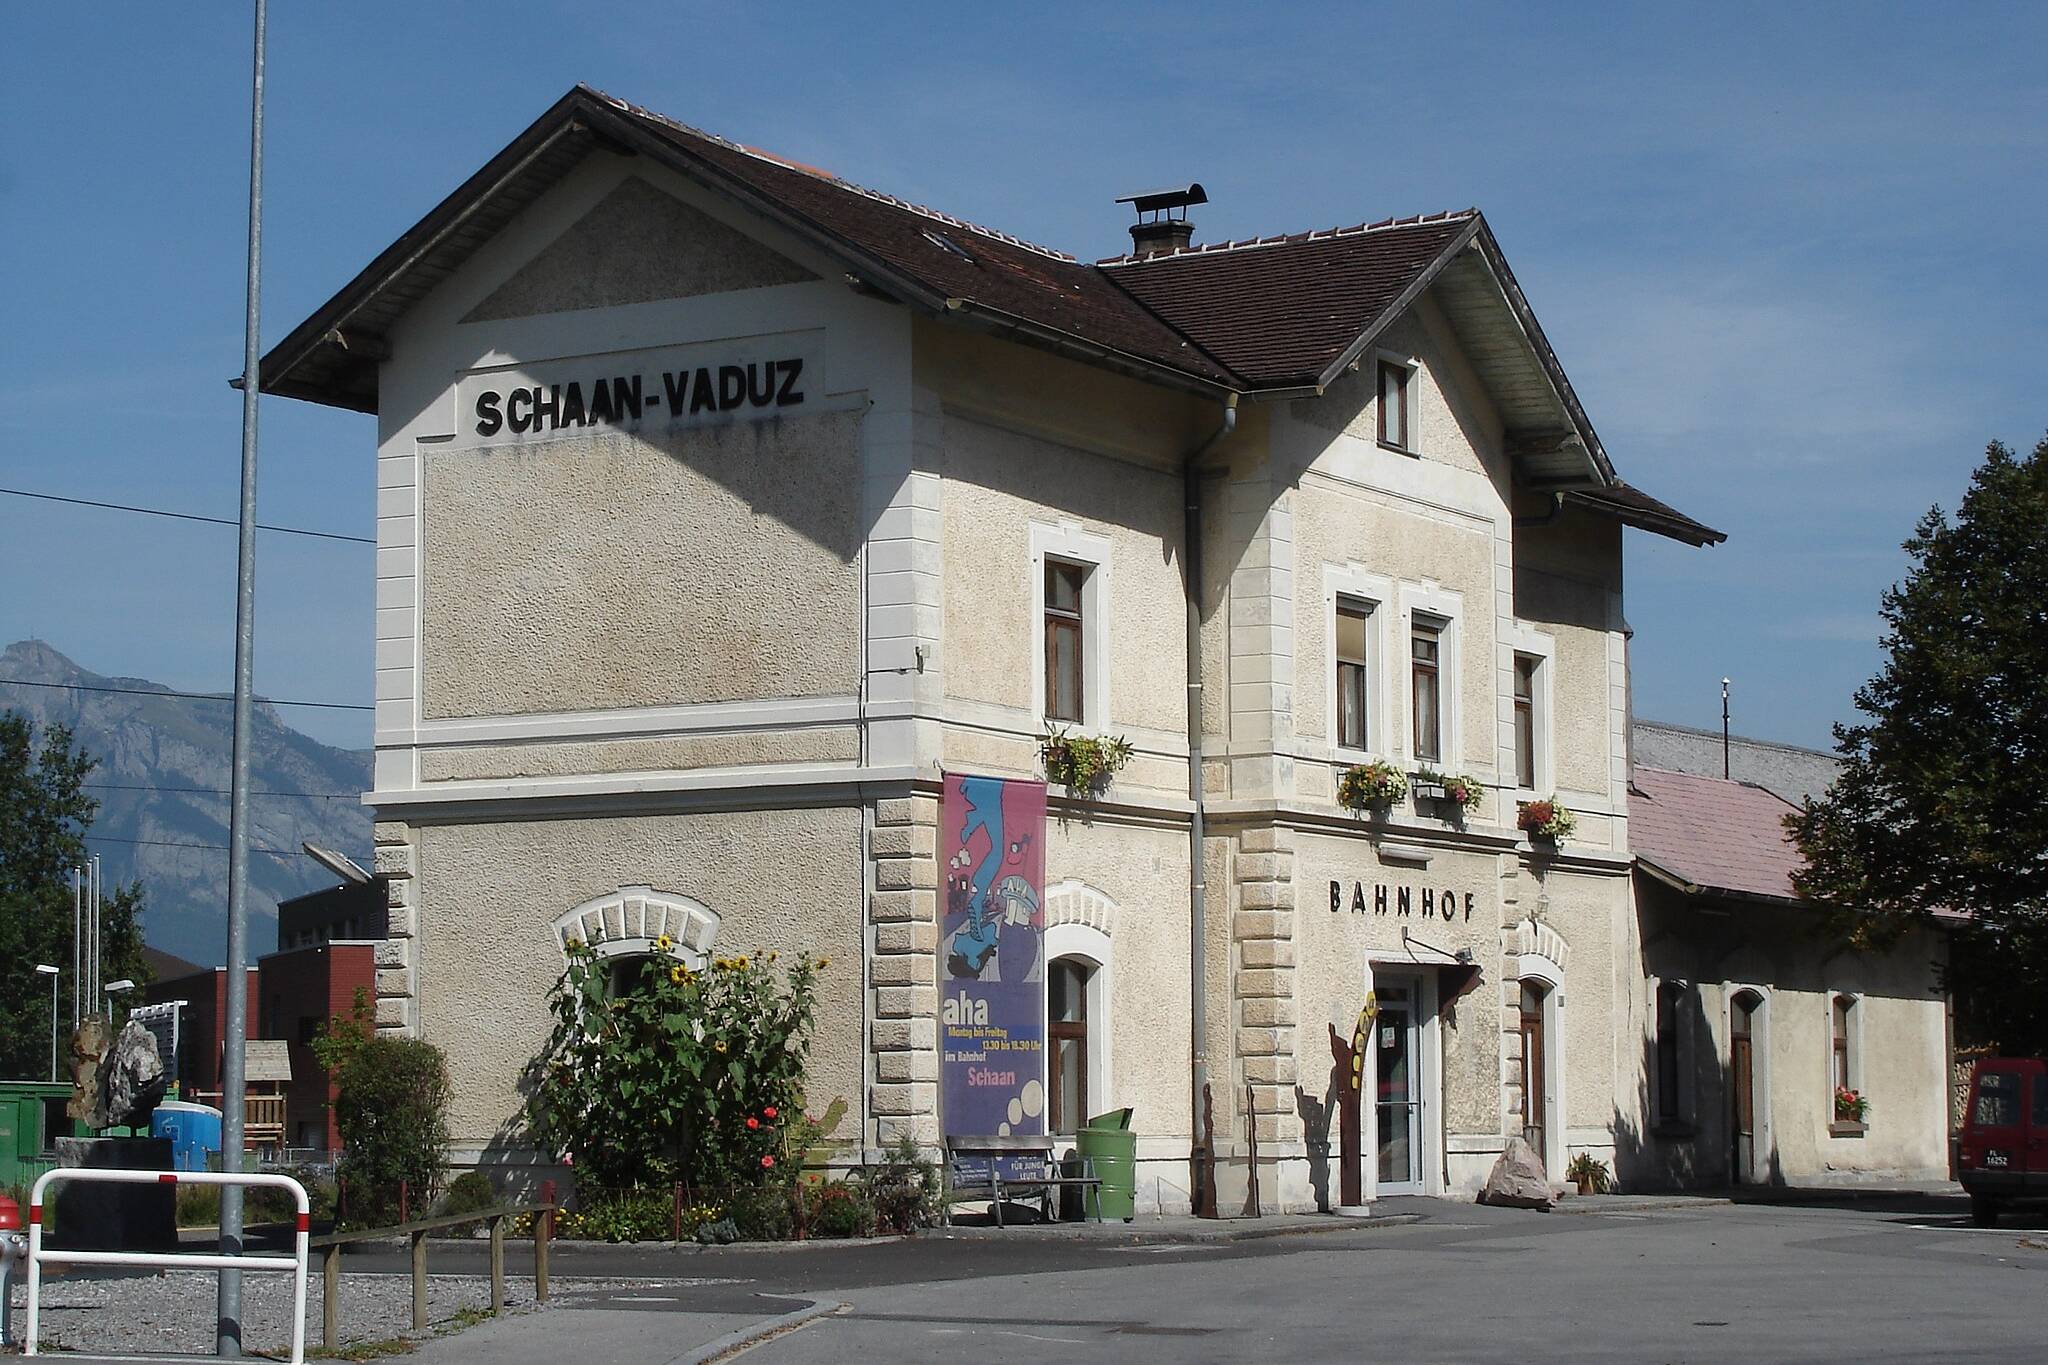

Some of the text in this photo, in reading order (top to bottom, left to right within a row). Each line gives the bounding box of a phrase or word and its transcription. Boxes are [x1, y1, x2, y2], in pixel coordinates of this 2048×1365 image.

[474, 357, 805, 438] SCHAAN-VADUZ
[1329, 879, 1475, 924] BAHNHOF
[943, 990, 989, 1026] aha
[948, 1026, 1008, 1040] Montag bis Freitag
[1000, 1040, 1011, 1051] bis
[1030, 1040, 1041, 1051] Uhr
[945, 1050, 987, 1063] im Bahnhof
[967, 1065, 1016, 1087] Schaan
[1011, 1160, 1024, 1171] FÜR
